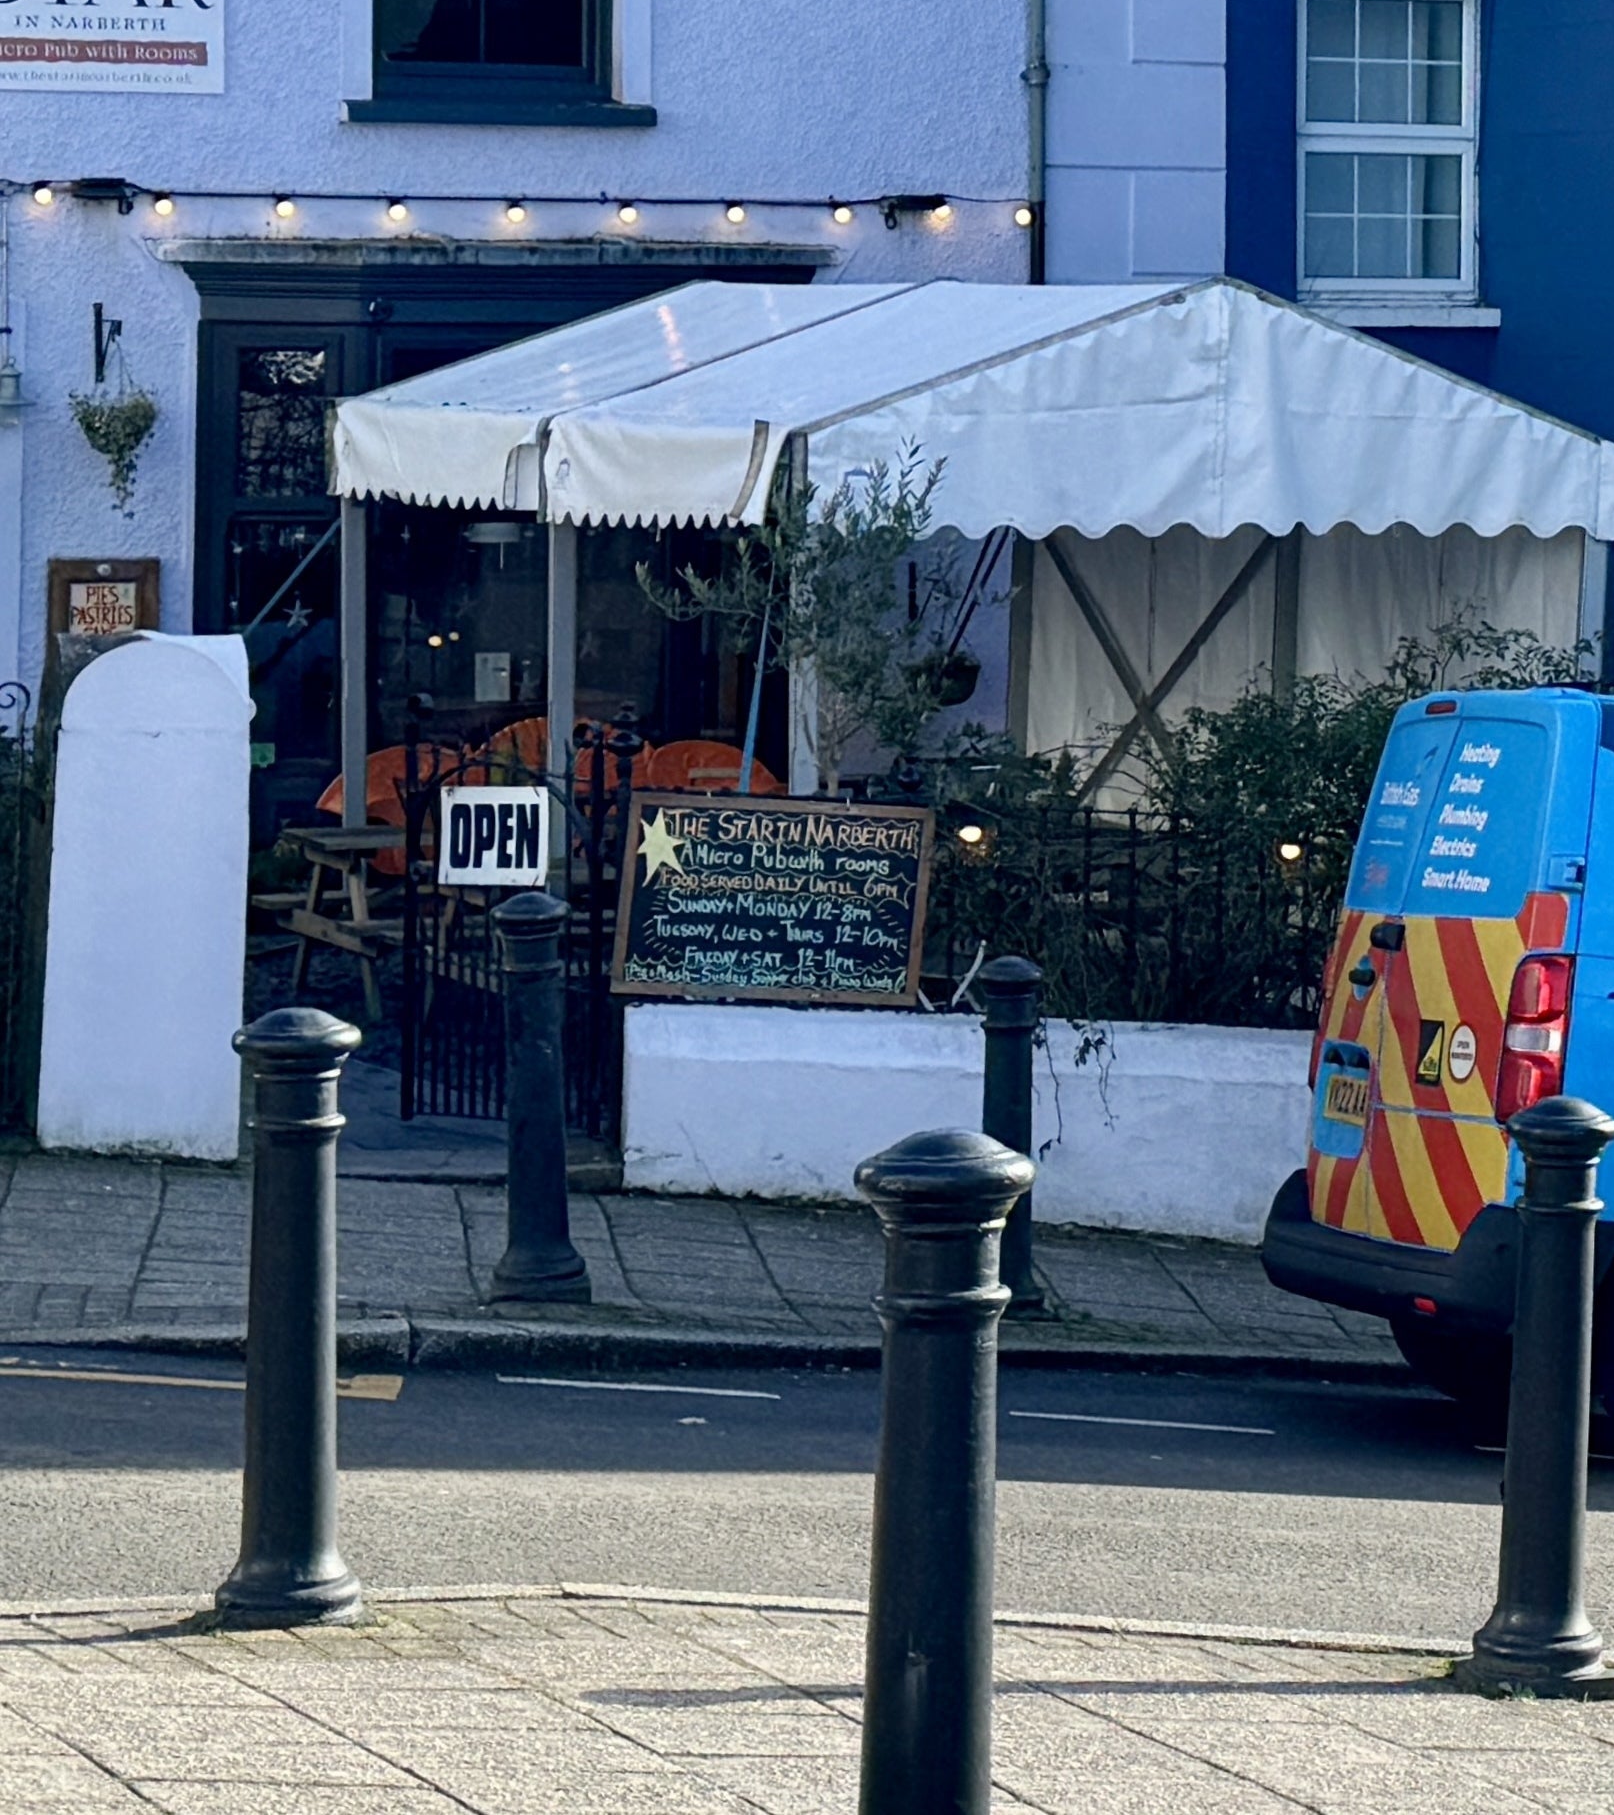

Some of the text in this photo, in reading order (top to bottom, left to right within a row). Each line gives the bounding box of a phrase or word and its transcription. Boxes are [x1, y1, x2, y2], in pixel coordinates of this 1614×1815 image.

[14, 15, 167, 32] IN NARBERTH
[44, 43, 79, 58] Pub
[86, 44, 128, 59] with
[134, 47, 198, 61] Rooms
[86, 586, 119, 605] PIES
[71, 605, 133, 625] PASTRIES
[1459, 743, 1501, 769] Heating
[1449, 772, 1485, 794] Drains
[1439, 803, 1489, 831] Plumbing
[449, 803, 539, 869] OPEN
[670, 809, 710, 839] THE
[718, 810, 776, 844] STAR
[804, 814, 914, 850] NARBERTH
[680, 838, 695, 865] A
[750, 841, 787, 869] Pub
[1429, 835, 1477, 858] Electrics
[660, 866, 699, 887] FOOD
[700, 870, 752, 890] SERVED
[754, 873, 807, 892] DAILY
[808, 875, 857, 895] UNTIL
[1422, 867, 1491, 893] Smart Home
[667, 887, 727, 914] SUNDAY
[735, 892, 814, 919] MONDAY
[721, 924, 763, 942] WED
[780, 920, 825, 943] THURS
[684, 945, 739, 967] FRIDAY
[751, 950, 783, 967] SAT
[701, 965, 748, 987] Sunday
